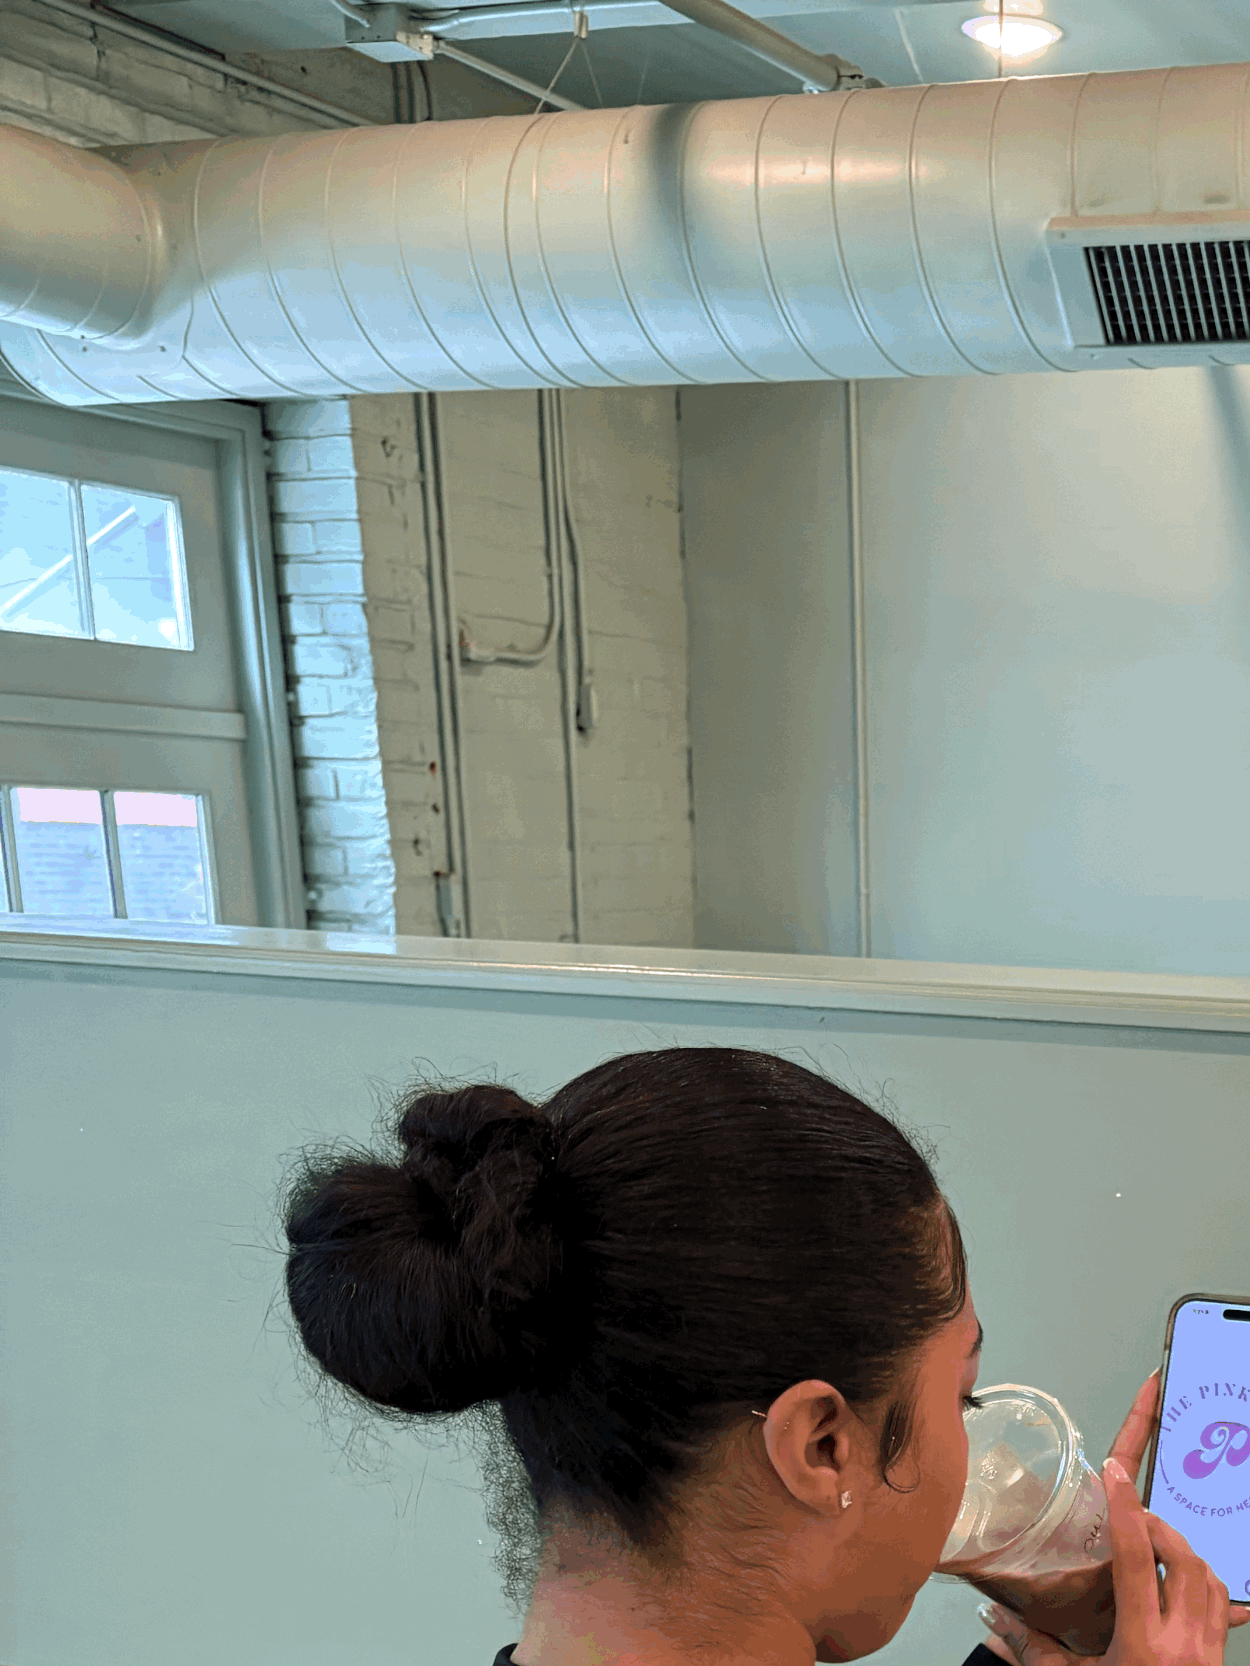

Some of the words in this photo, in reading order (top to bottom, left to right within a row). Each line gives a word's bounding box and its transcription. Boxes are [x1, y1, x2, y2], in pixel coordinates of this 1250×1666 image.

[1166, 1486, 1176, 1495] A
[1173, 1492, 1208, 1517] SPACE
[1210, 1506, 1234, 1518] FOR
